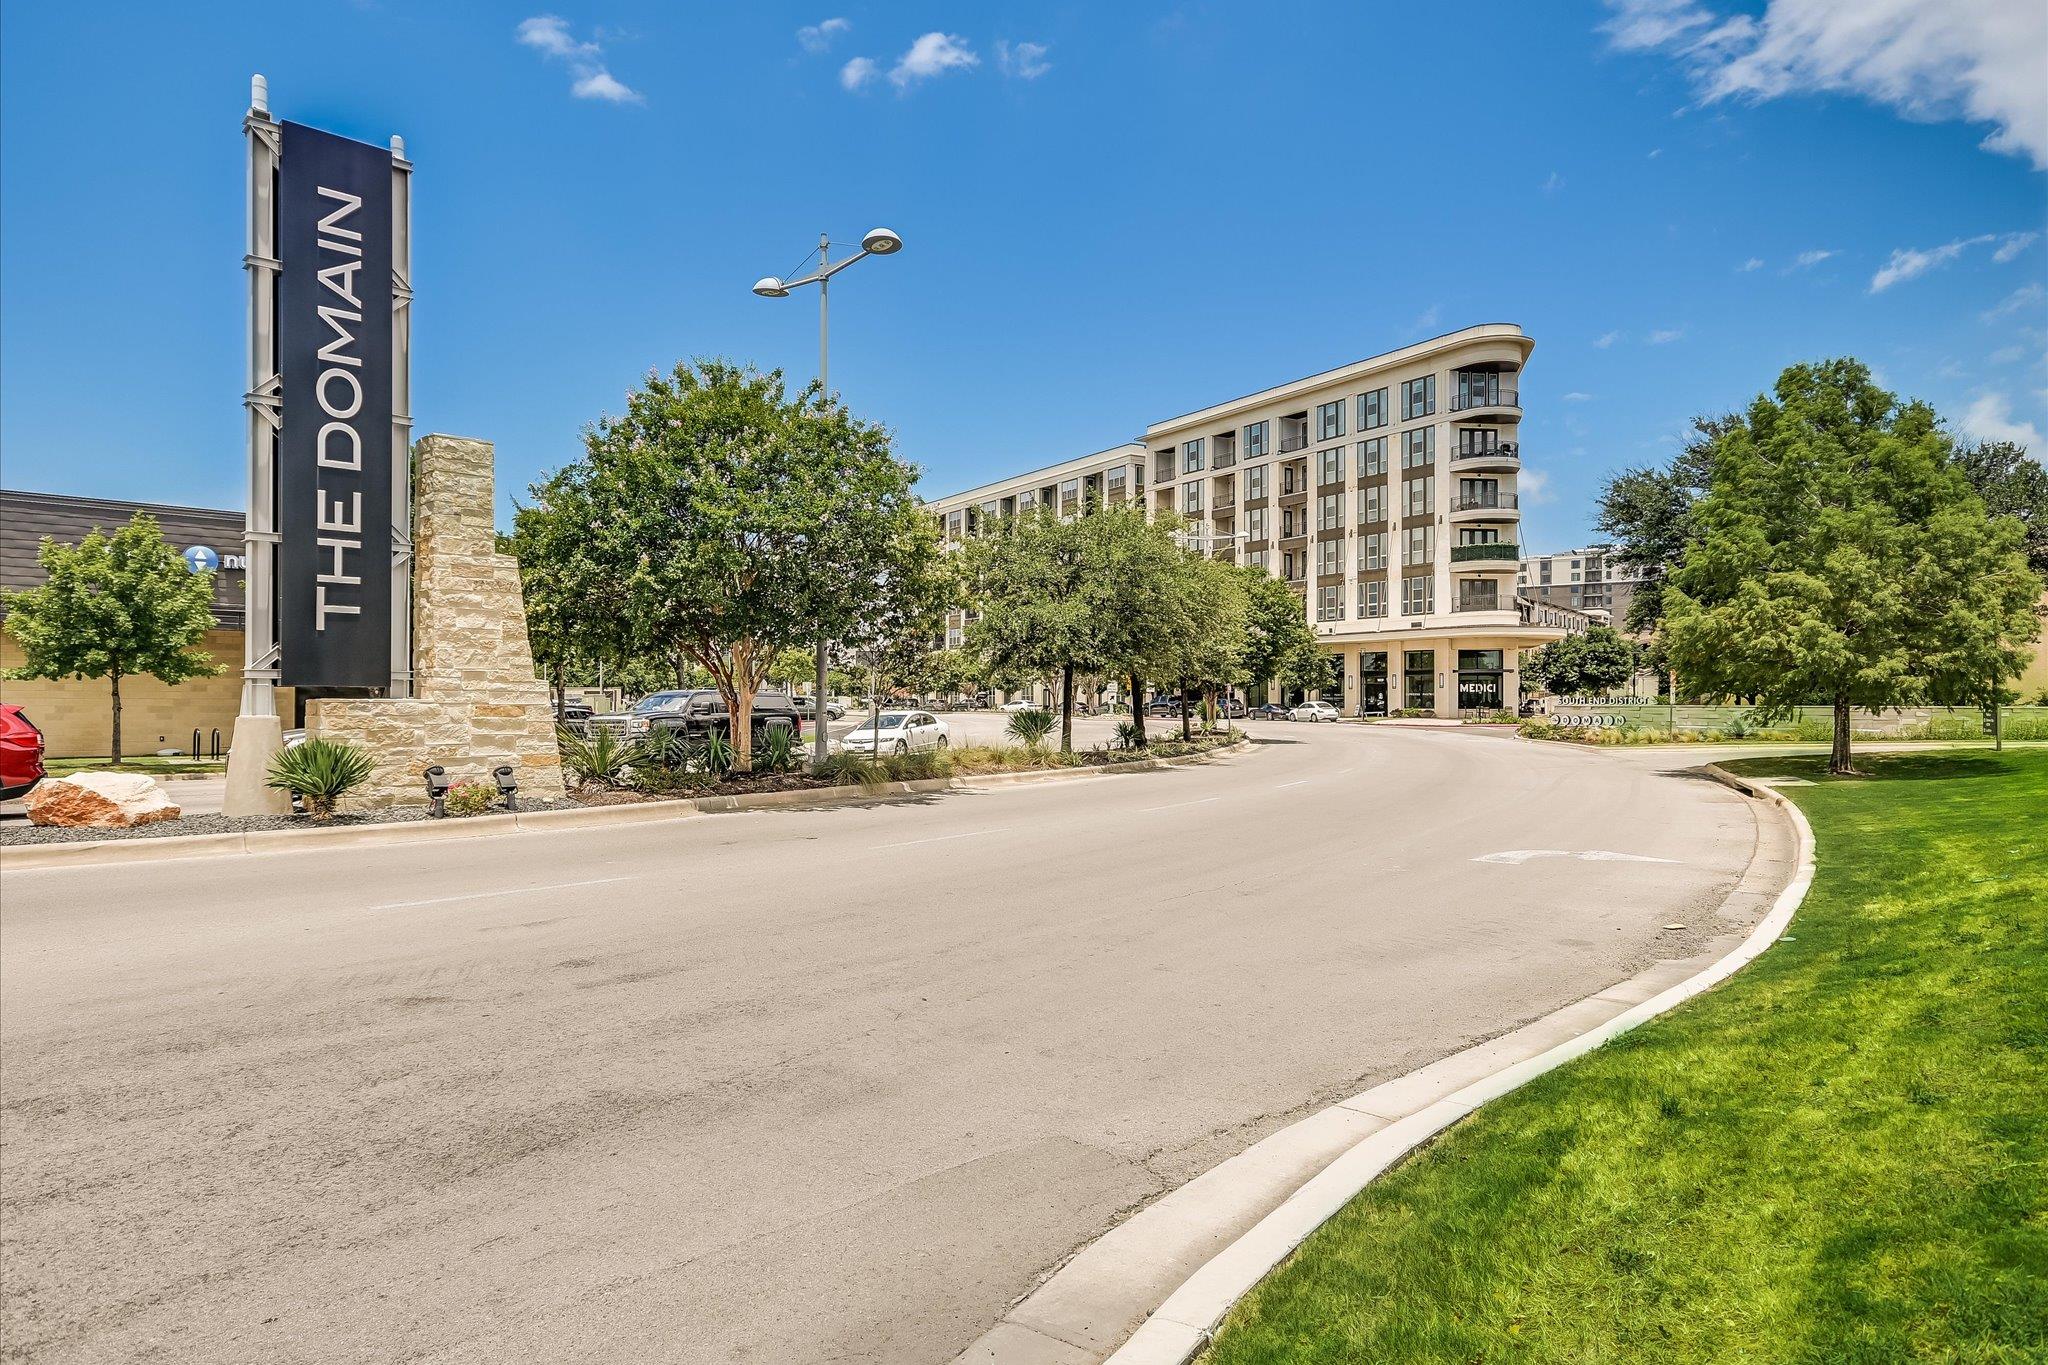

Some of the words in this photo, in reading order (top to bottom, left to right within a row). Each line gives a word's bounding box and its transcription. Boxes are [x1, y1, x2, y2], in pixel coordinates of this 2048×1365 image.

[315, 185, 363, 472] DOMAIN
[315, 489, 361, 631] THE
[1459, 683, 1496, 693] MEDICI
[1557, 697, 1587, 705] SOUTH
[1588, 697, 1607, 705] END
[1609, 697, 1649, 705] DISTRICT
